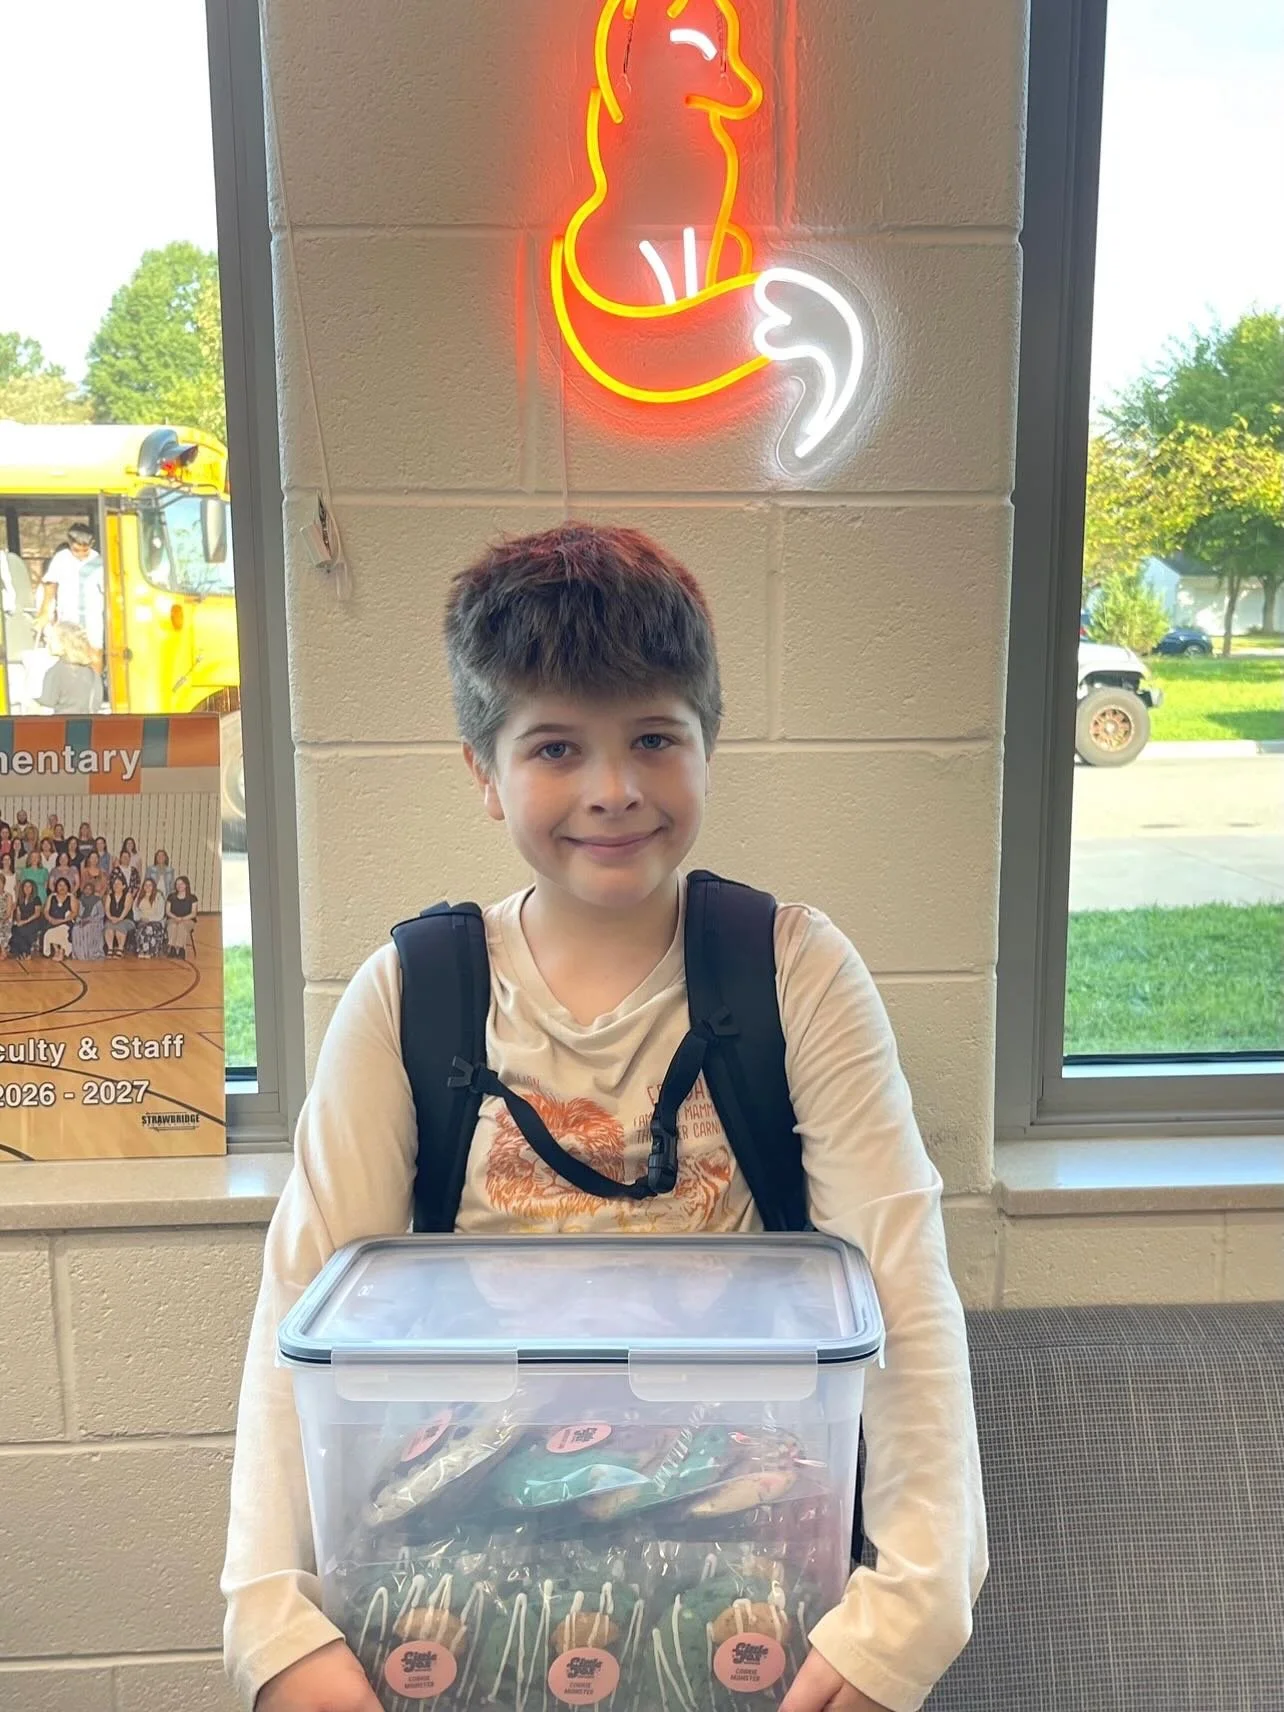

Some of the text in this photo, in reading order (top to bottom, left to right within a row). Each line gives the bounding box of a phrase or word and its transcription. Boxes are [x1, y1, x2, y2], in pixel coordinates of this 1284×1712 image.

[0, 745, 141, 781] entary
[77, 1036, 99, 1061] &
[110, 1034, 184, 1060] Staff
[82, 1080, 150, 1105] 2027
[141, 1114, 200, 1125] STRAWBRIDGE
[684, 1103, 715, 1121] MAMM
